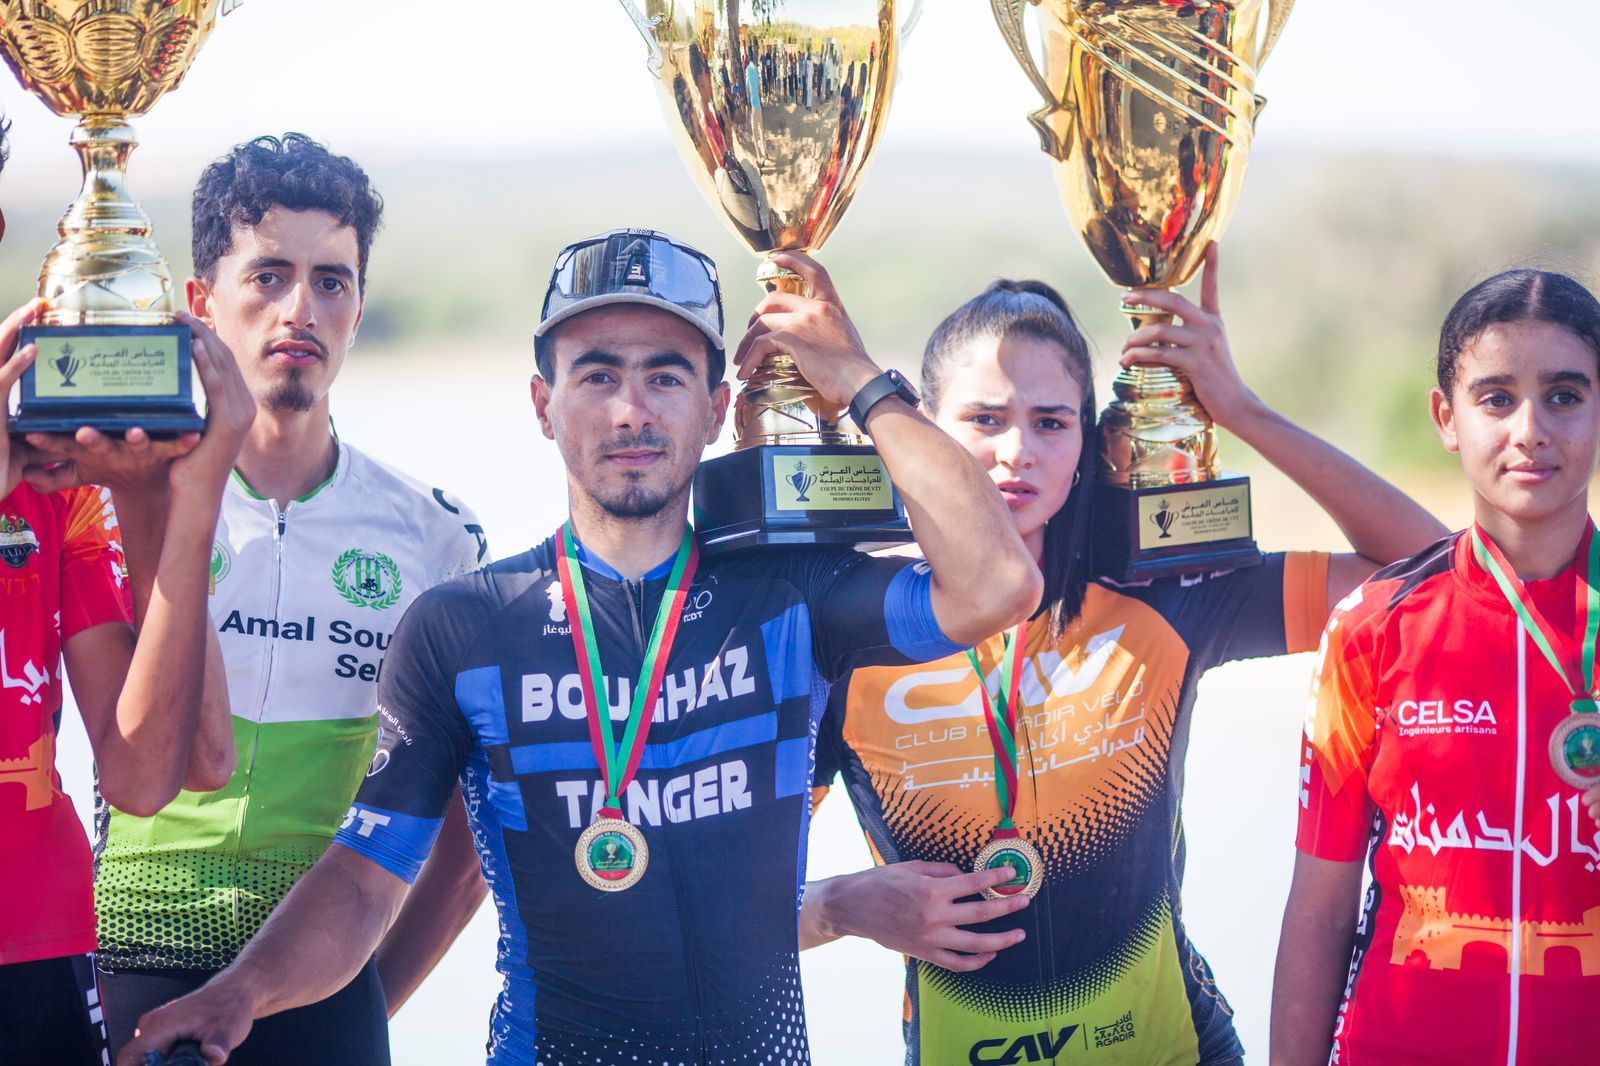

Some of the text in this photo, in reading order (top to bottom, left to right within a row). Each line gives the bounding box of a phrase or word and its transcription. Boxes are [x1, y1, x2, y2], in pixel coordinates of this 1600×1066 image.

[219, 609, 315, 641] Amal
[543, 624, 572, 635] لبوغاز
[896, 680, 1144, 750] CLUB AADIR VELO
[1073, 702, 1145, 746] نادي
[1398, 700, 1497, 725] CELSA
[1399, 725, 1497, 737] Ingénieurs artisans
[903, 763, 1020, 792] ابلية
[969, 1024, 1079, 1066] CAV
[1096, 1030, 1136, 1049] AGADIR
